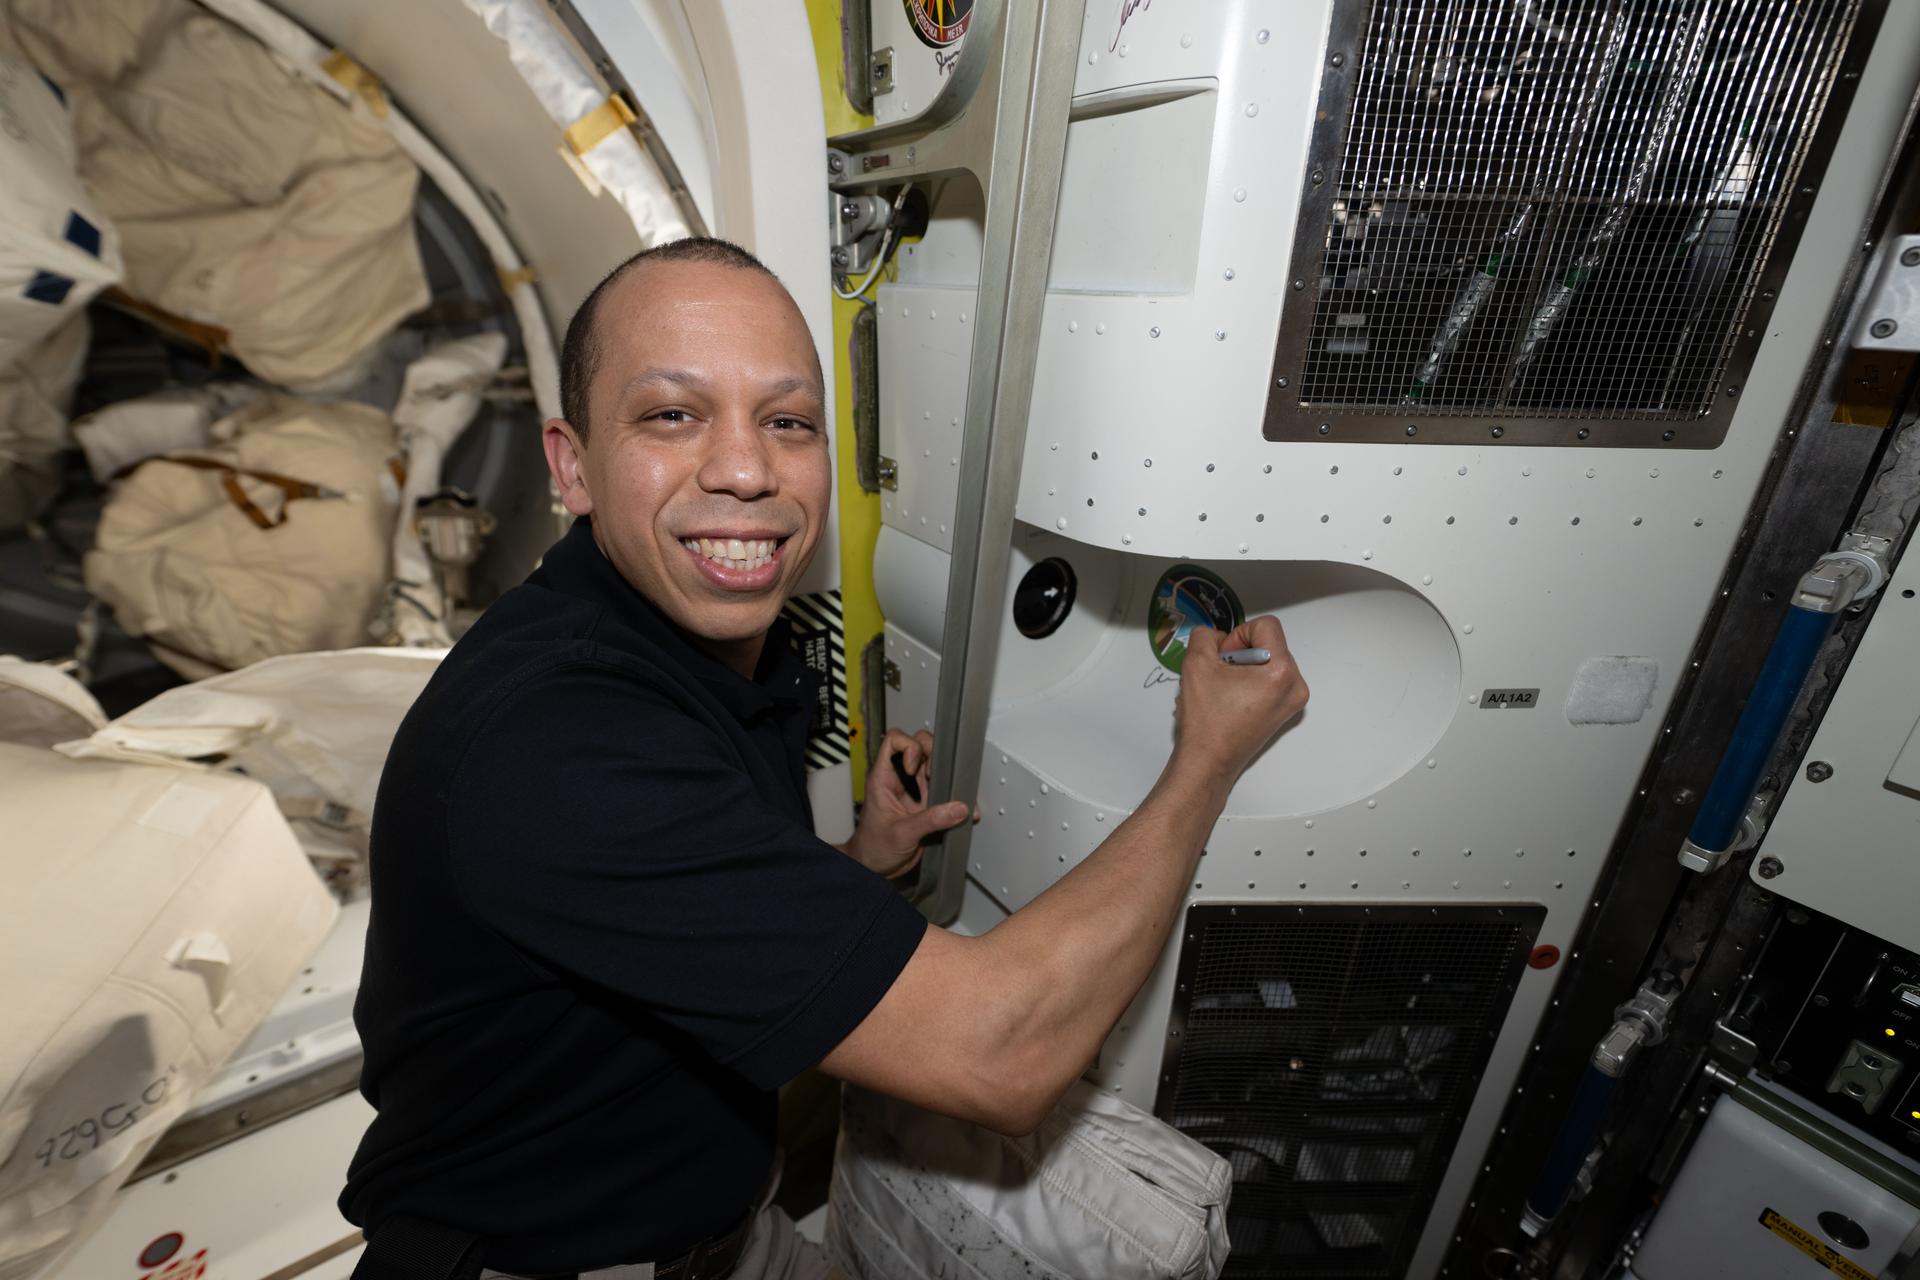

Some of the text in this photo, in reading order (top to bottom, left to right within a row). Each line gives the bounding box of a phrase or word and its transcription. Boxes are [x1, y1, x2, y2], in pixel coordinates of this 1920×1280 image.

[947, 24, 964, 41] MEIR
[803, 639, 816, 670] HATC
[818, 685, 831, 728] BEFORE
[1488, 693, 1532, 703] A/L1A2
[1892, 966, 1908, 976] ON
[1892, 1009, 1912, 1022] OFF
[1769, 1214, 1821, 1252] MANUAL
